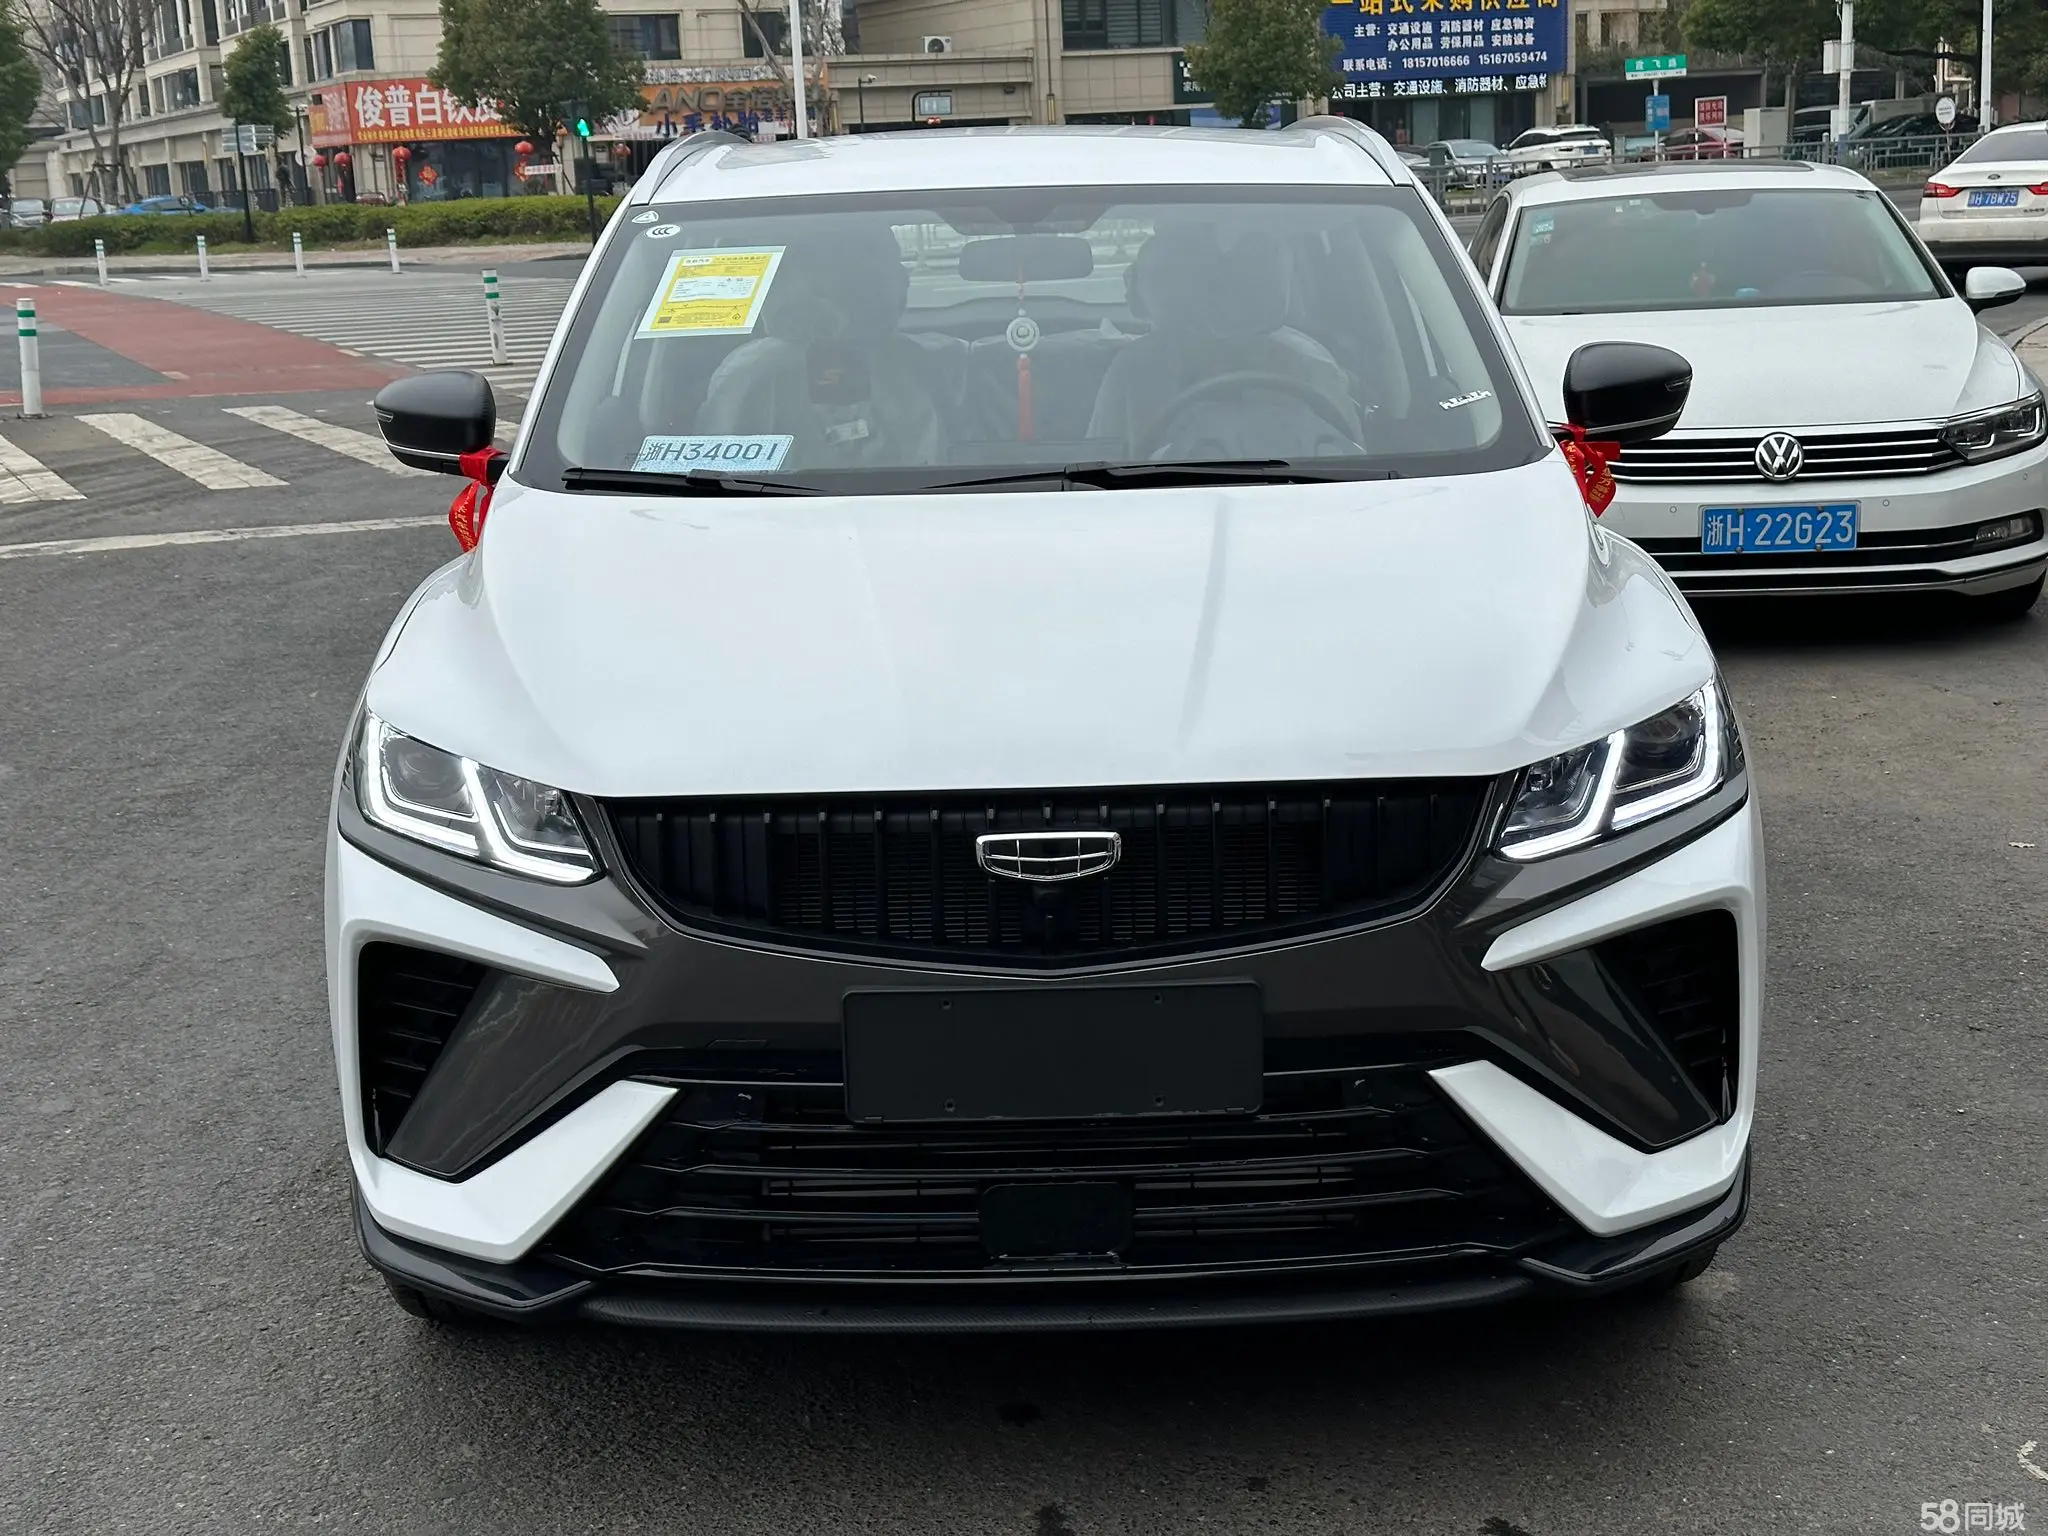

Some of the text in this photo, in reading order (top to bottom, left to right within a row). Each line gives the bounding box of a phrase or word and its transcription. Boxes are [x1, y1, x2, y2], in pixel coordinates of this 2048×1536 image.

[1440, 18, 1484, 34] 消防器材
[1491, 16, 1535, 32] 应急物资
[1387, 33, 1535, 52] 办公用品 劳保用品 安防设备
[1401, 55, 1470, 69] 18157016666
[1478, 51, 1548, 66] 15167059474
[641, 442, 778, 462] 浙H34001
